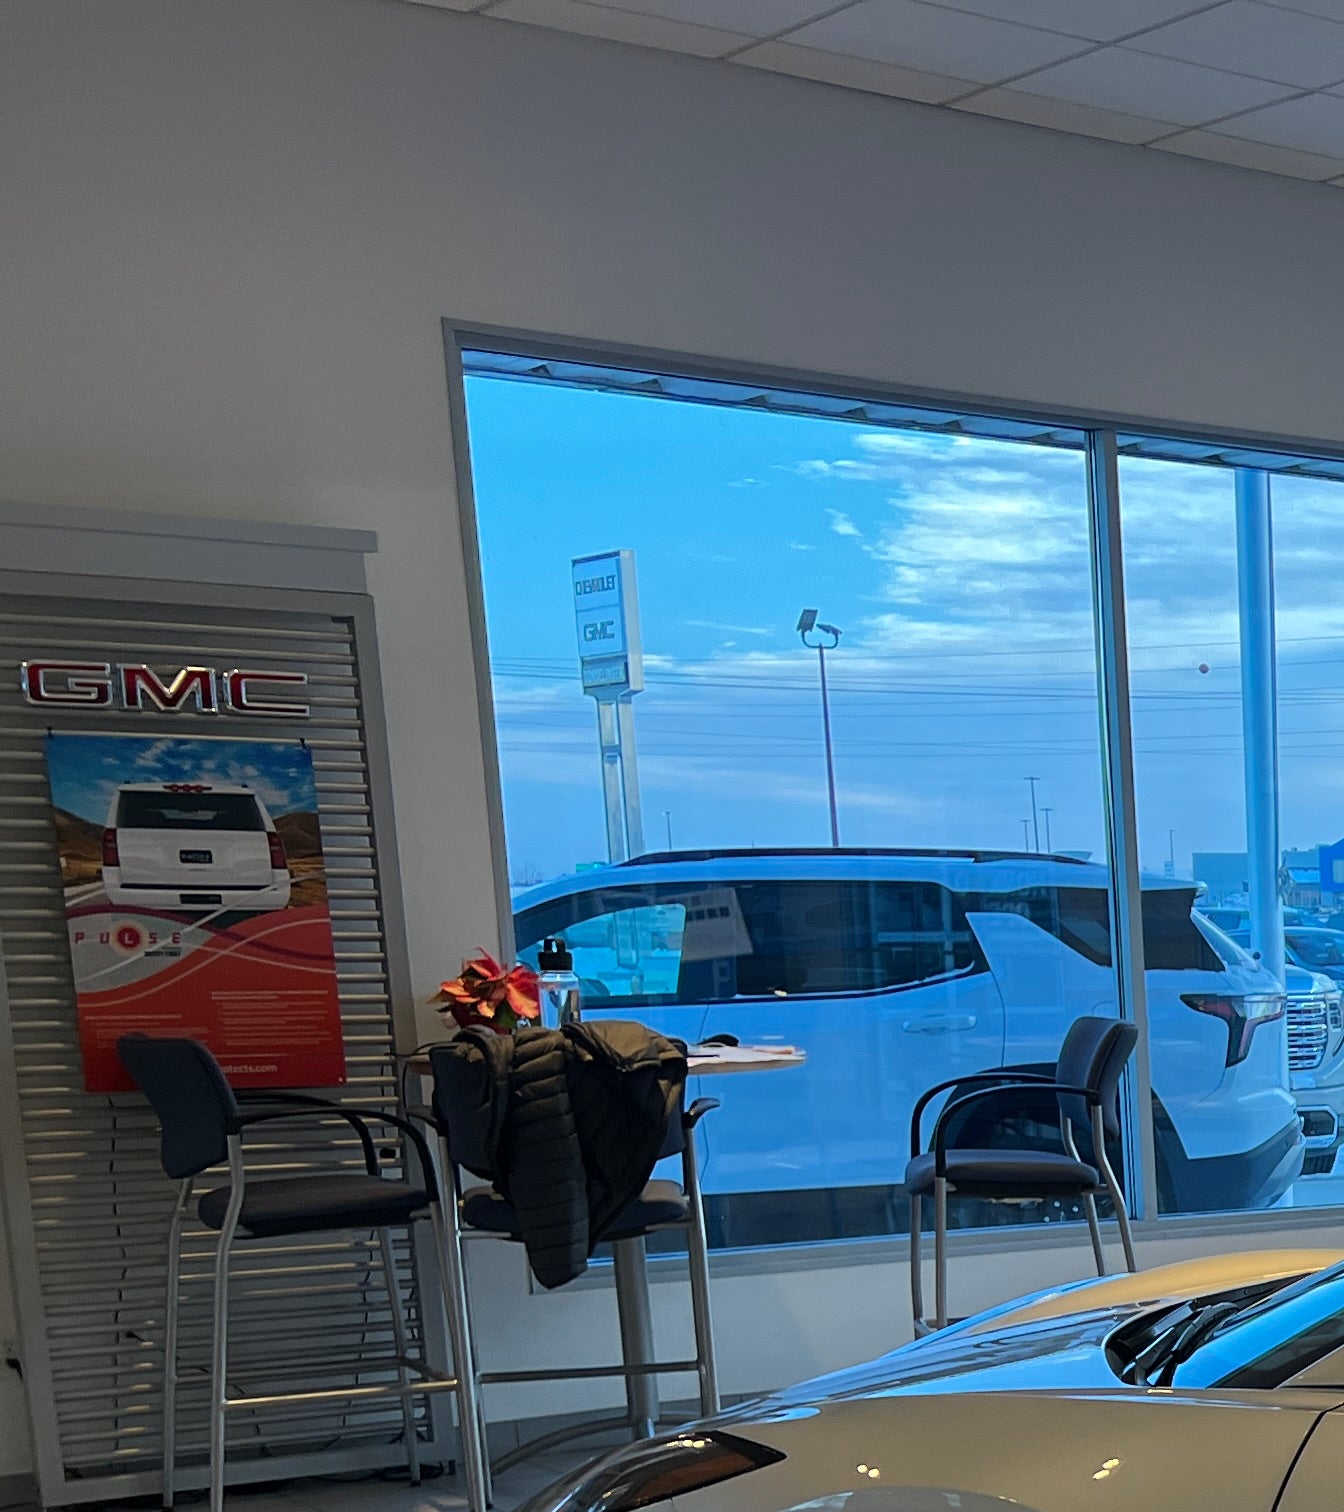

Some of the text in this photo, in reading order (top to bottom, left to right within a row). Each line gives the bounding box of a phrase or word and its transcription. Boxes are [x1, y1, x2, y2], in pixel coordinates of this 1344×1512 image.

[584, 620, 615, 642] GMC
[21, 659, 310, 718] GMC
[75, 931, 182, 945] PULSE
[221, 1063, 278, 1074] otects.com
